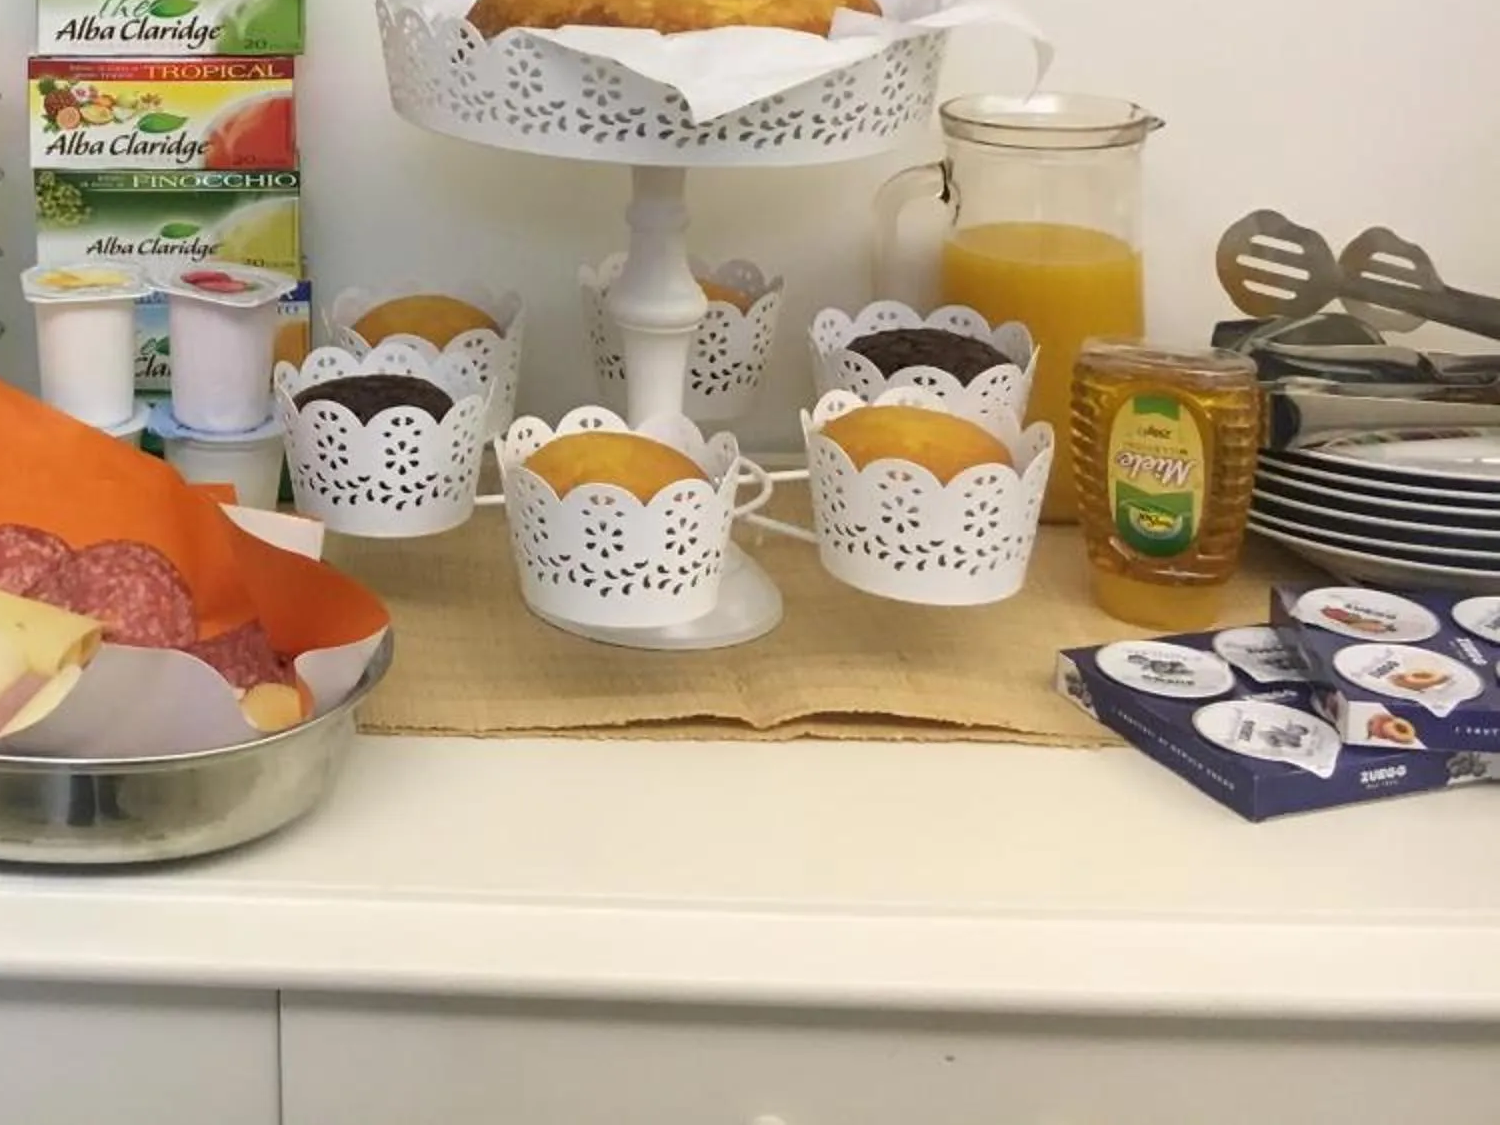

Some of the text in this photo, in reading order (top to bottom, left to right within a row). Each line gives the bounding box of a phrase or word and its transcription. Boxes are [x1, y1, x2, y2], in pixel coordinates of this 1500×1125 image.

[55, 16, 223, 51] Alba Claridge
[146, 63, 283, 80] TROPICAL
[45, 131, 212, 165] Alba Claridge
[132, 173, 298, 189] FINOCCHIO
[86, 234, 222, 263] Alba Claridge
[1115, 448, 1201, 487] Miele
